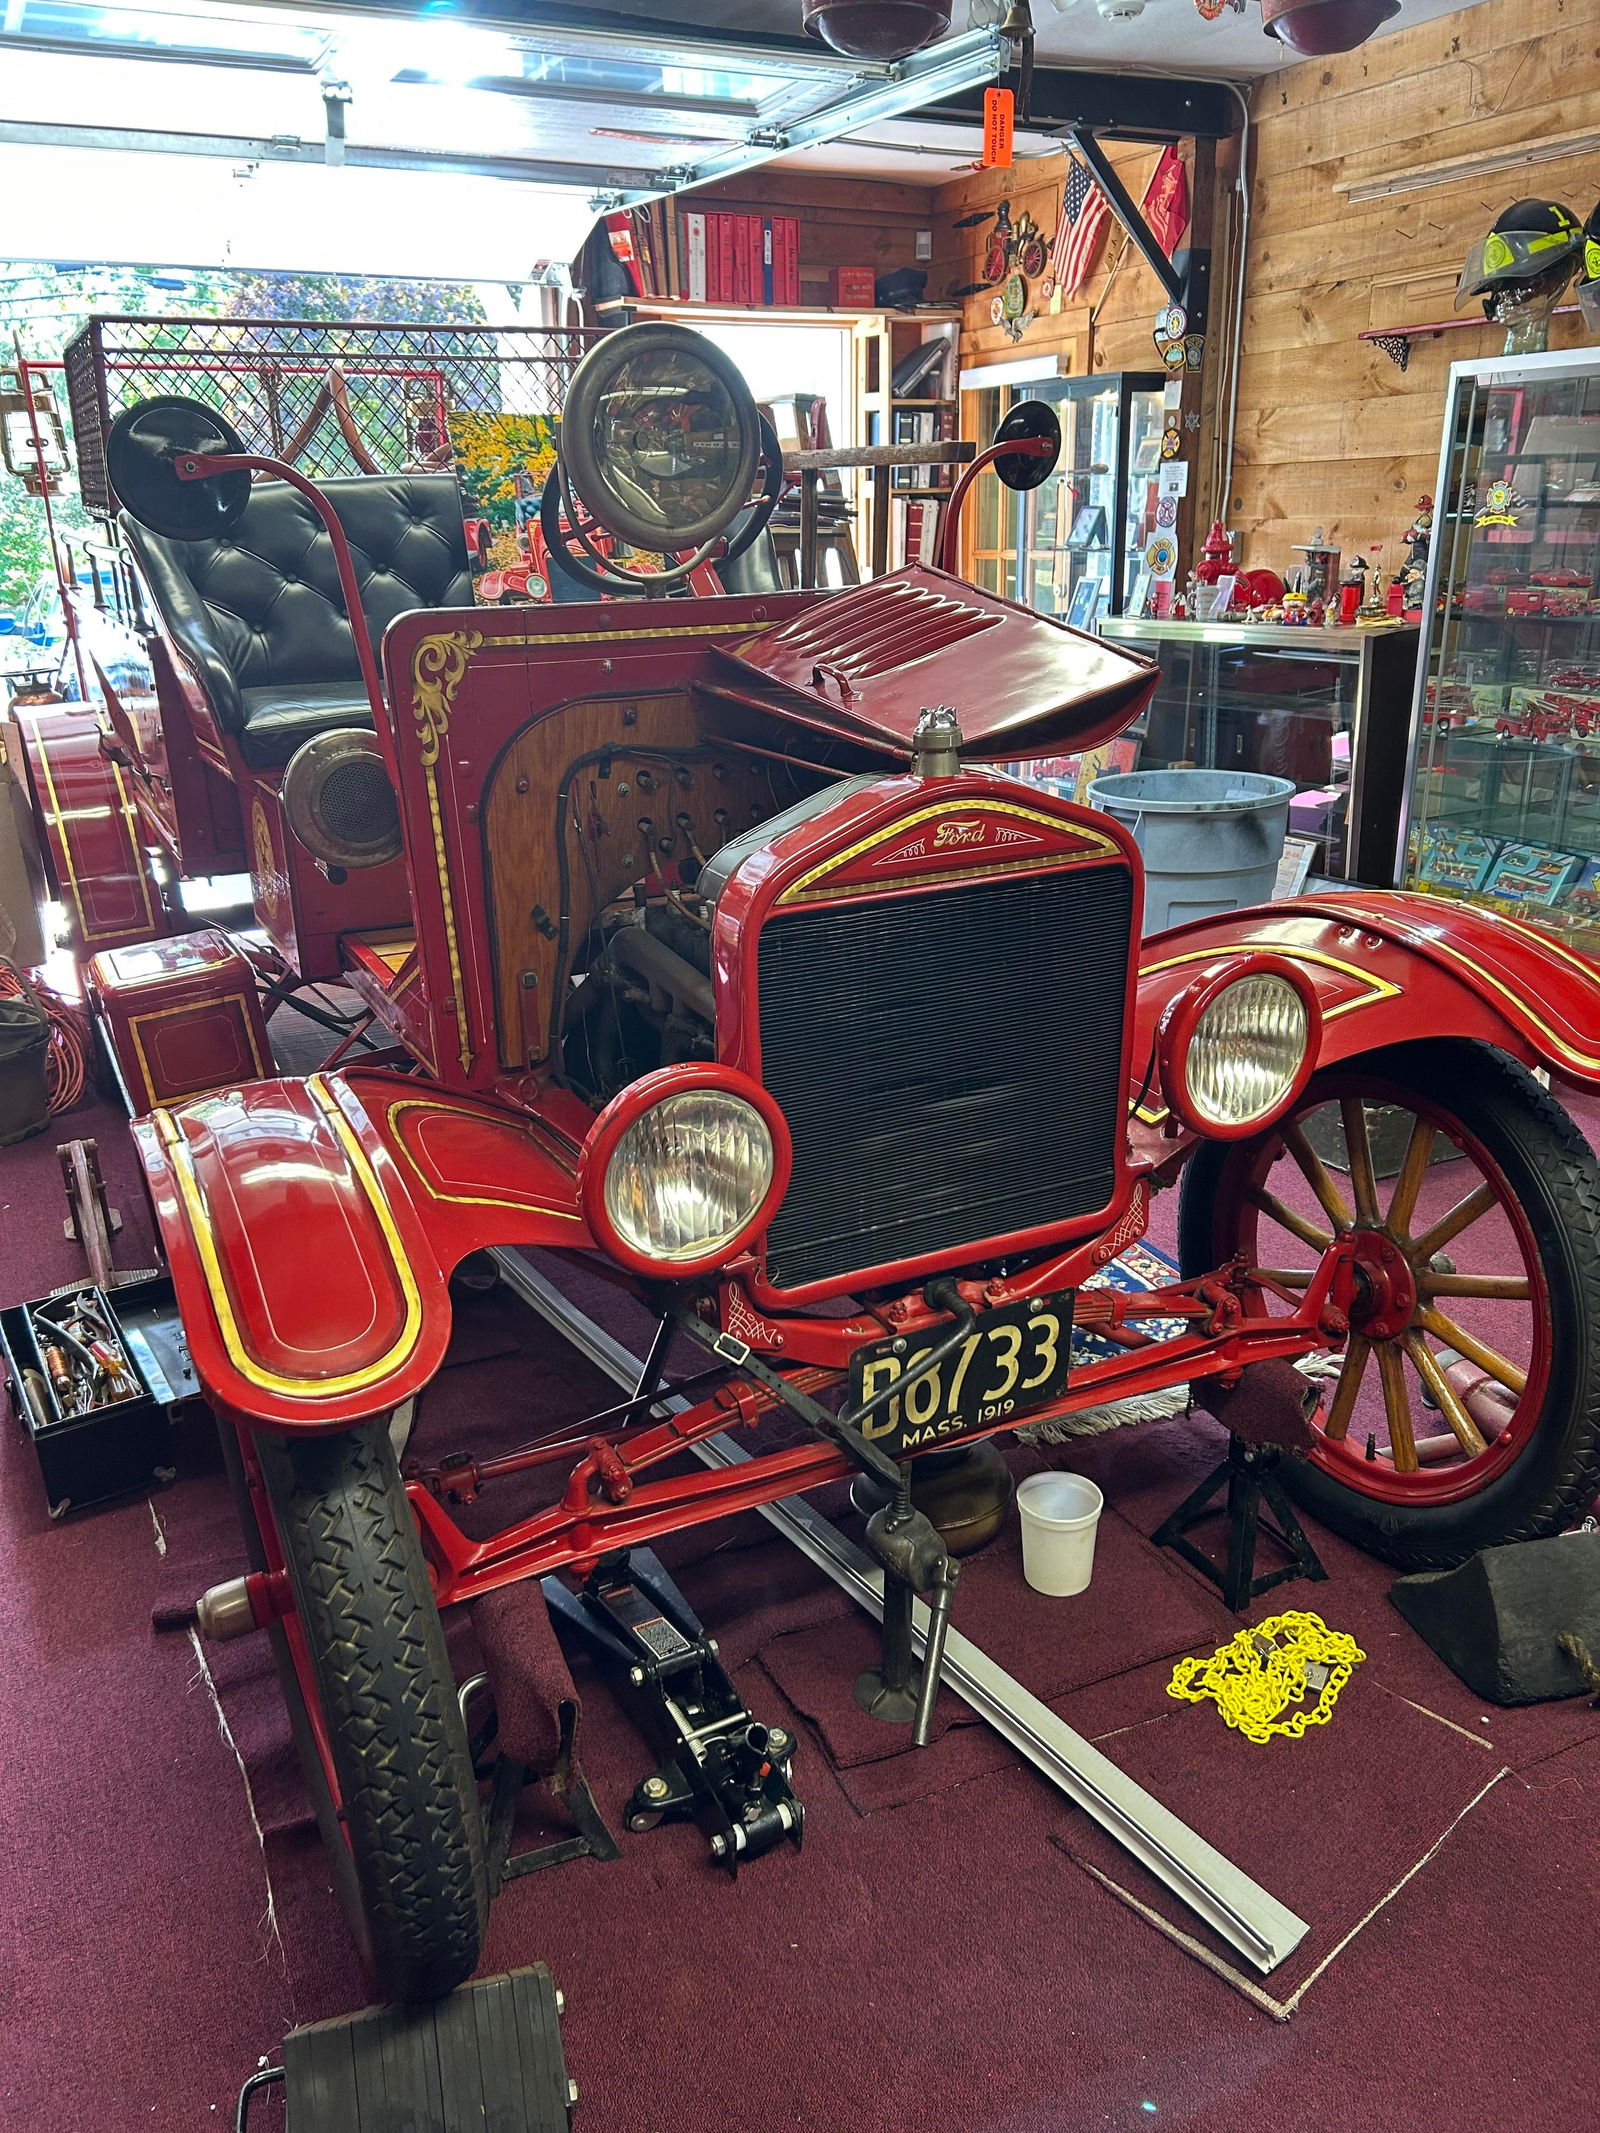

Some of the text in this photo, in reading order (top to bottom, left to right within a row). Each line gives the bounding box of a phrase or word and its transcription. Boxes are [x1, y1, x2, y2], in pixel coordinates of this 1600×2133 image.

[991, 99, 998, 112] DO
[1548, 205, 1571, 228] 1
[932, 819, 986, 848] Ford
[902, 1398, 1015, 1449] MASS. 1919
